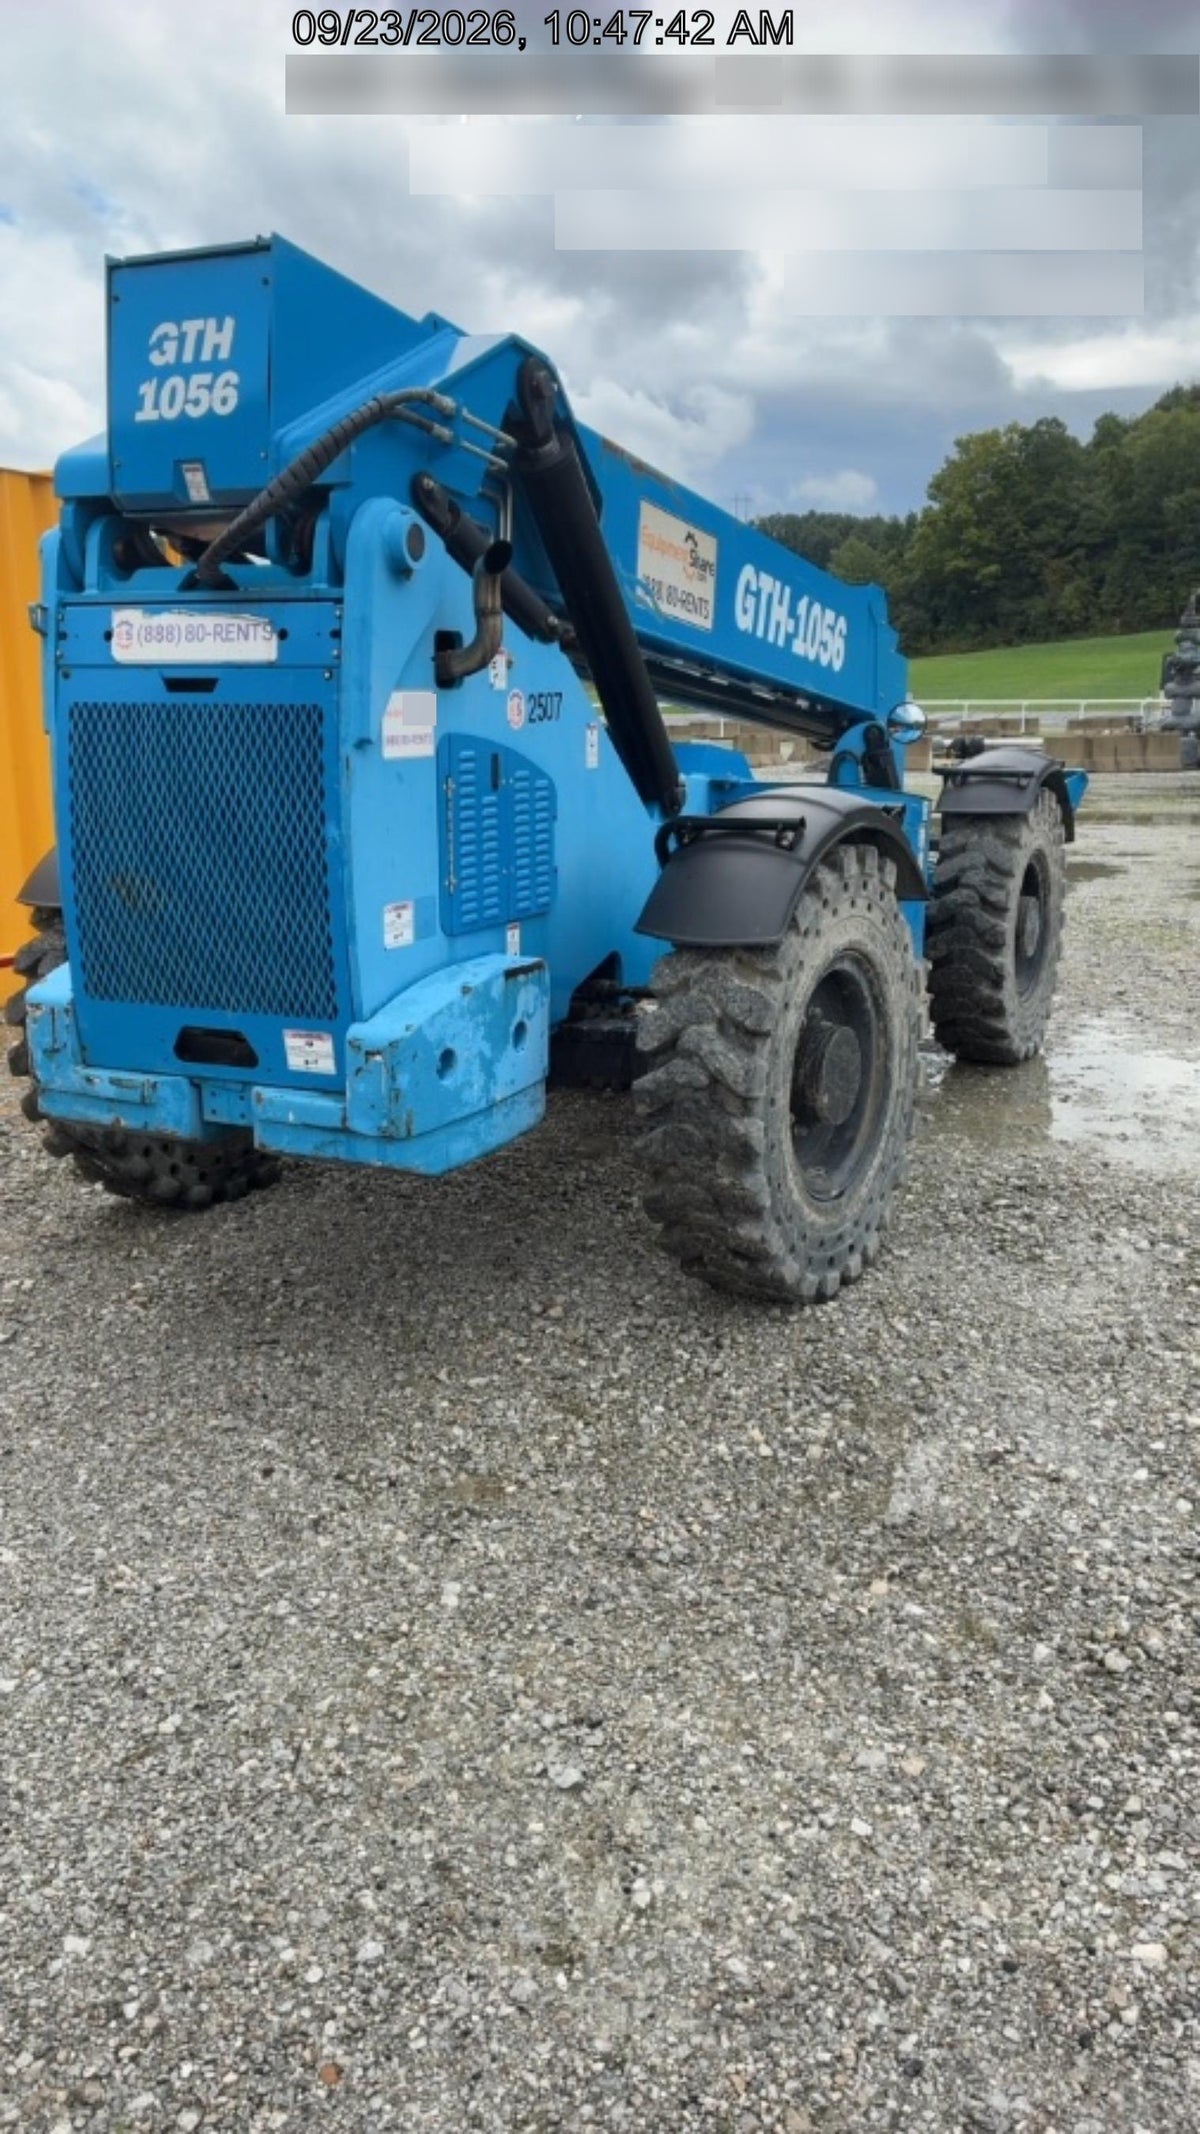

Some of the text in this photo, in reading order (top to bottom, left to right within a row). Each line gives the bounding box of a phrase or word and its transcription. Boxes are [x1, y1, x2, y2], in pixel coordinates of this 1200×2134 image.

[149, 315, 235, 366] GTH
[134, 370, 240, 422] 1056
[735, 563, 847, 672] GTH-1056
[528, 692, 563, 723] 2507
